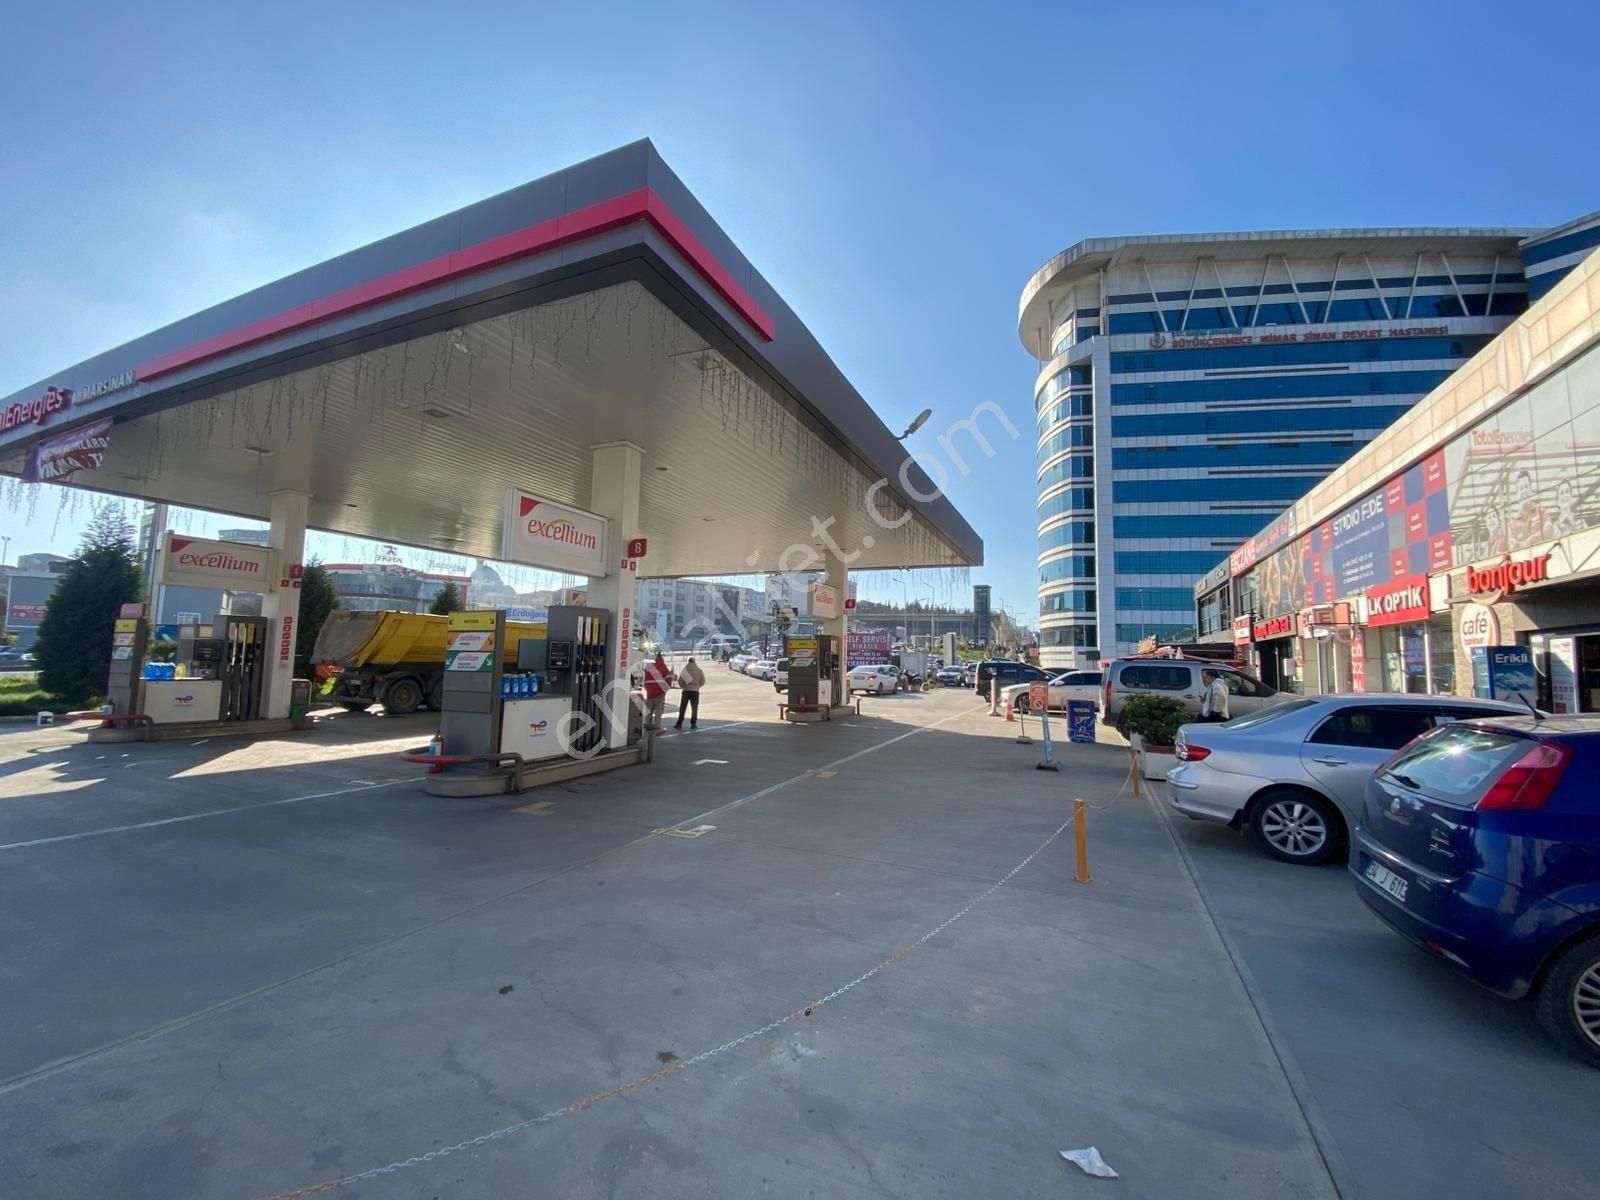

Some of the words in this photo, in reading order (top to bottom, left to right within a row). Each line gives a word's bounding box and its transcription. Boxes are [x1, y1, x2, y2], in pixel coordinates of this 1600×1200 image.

[1260, 333, 1297, 343] MİMAR
[1304, 331, 1336, 341] SİNAN
[1342, 329, 1382, 339] DEVLET
[1389, 325, 1448, 336] HASTANESİ
[528, 519, 596, 549] excellium
[635, 542, 642, 553] 8
[179, 552, 259, 573] excellium
[1464, 552, 1552, 596] bonjour
[1385, 585, 1423, 612] OPTİK
[1462, 611, 1488, 635] café
[848, 635, 859, 643] ELF
[1495, 653, 1528, 663] Erikli
